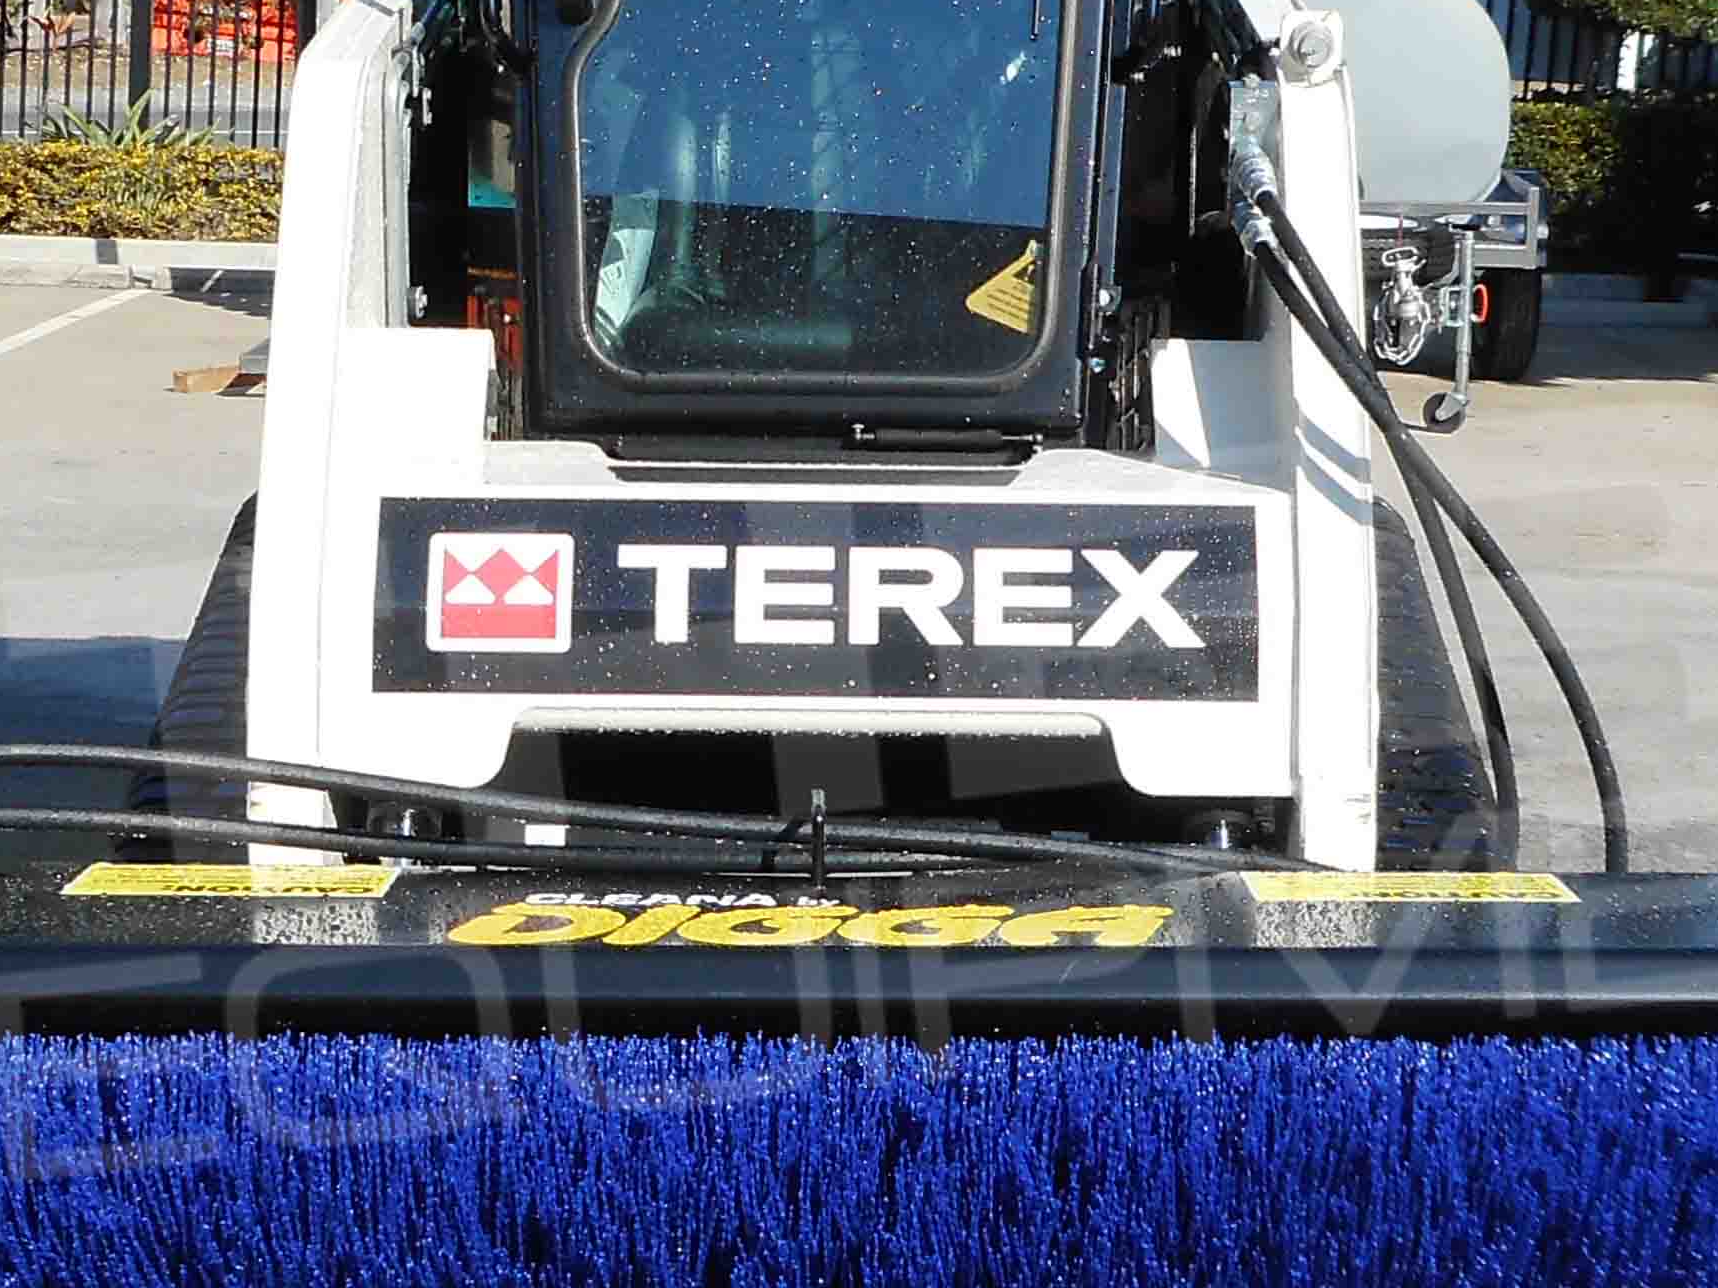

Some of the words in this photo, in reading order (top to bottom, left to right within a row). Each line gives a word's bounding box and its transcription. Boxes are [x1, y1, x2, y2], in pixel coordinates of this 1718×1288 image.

[616, 543, 1205, 647] TEREX
[522, 892, 777, 908] CLEANA
[447, 902, 1174, 946] DIGGA
